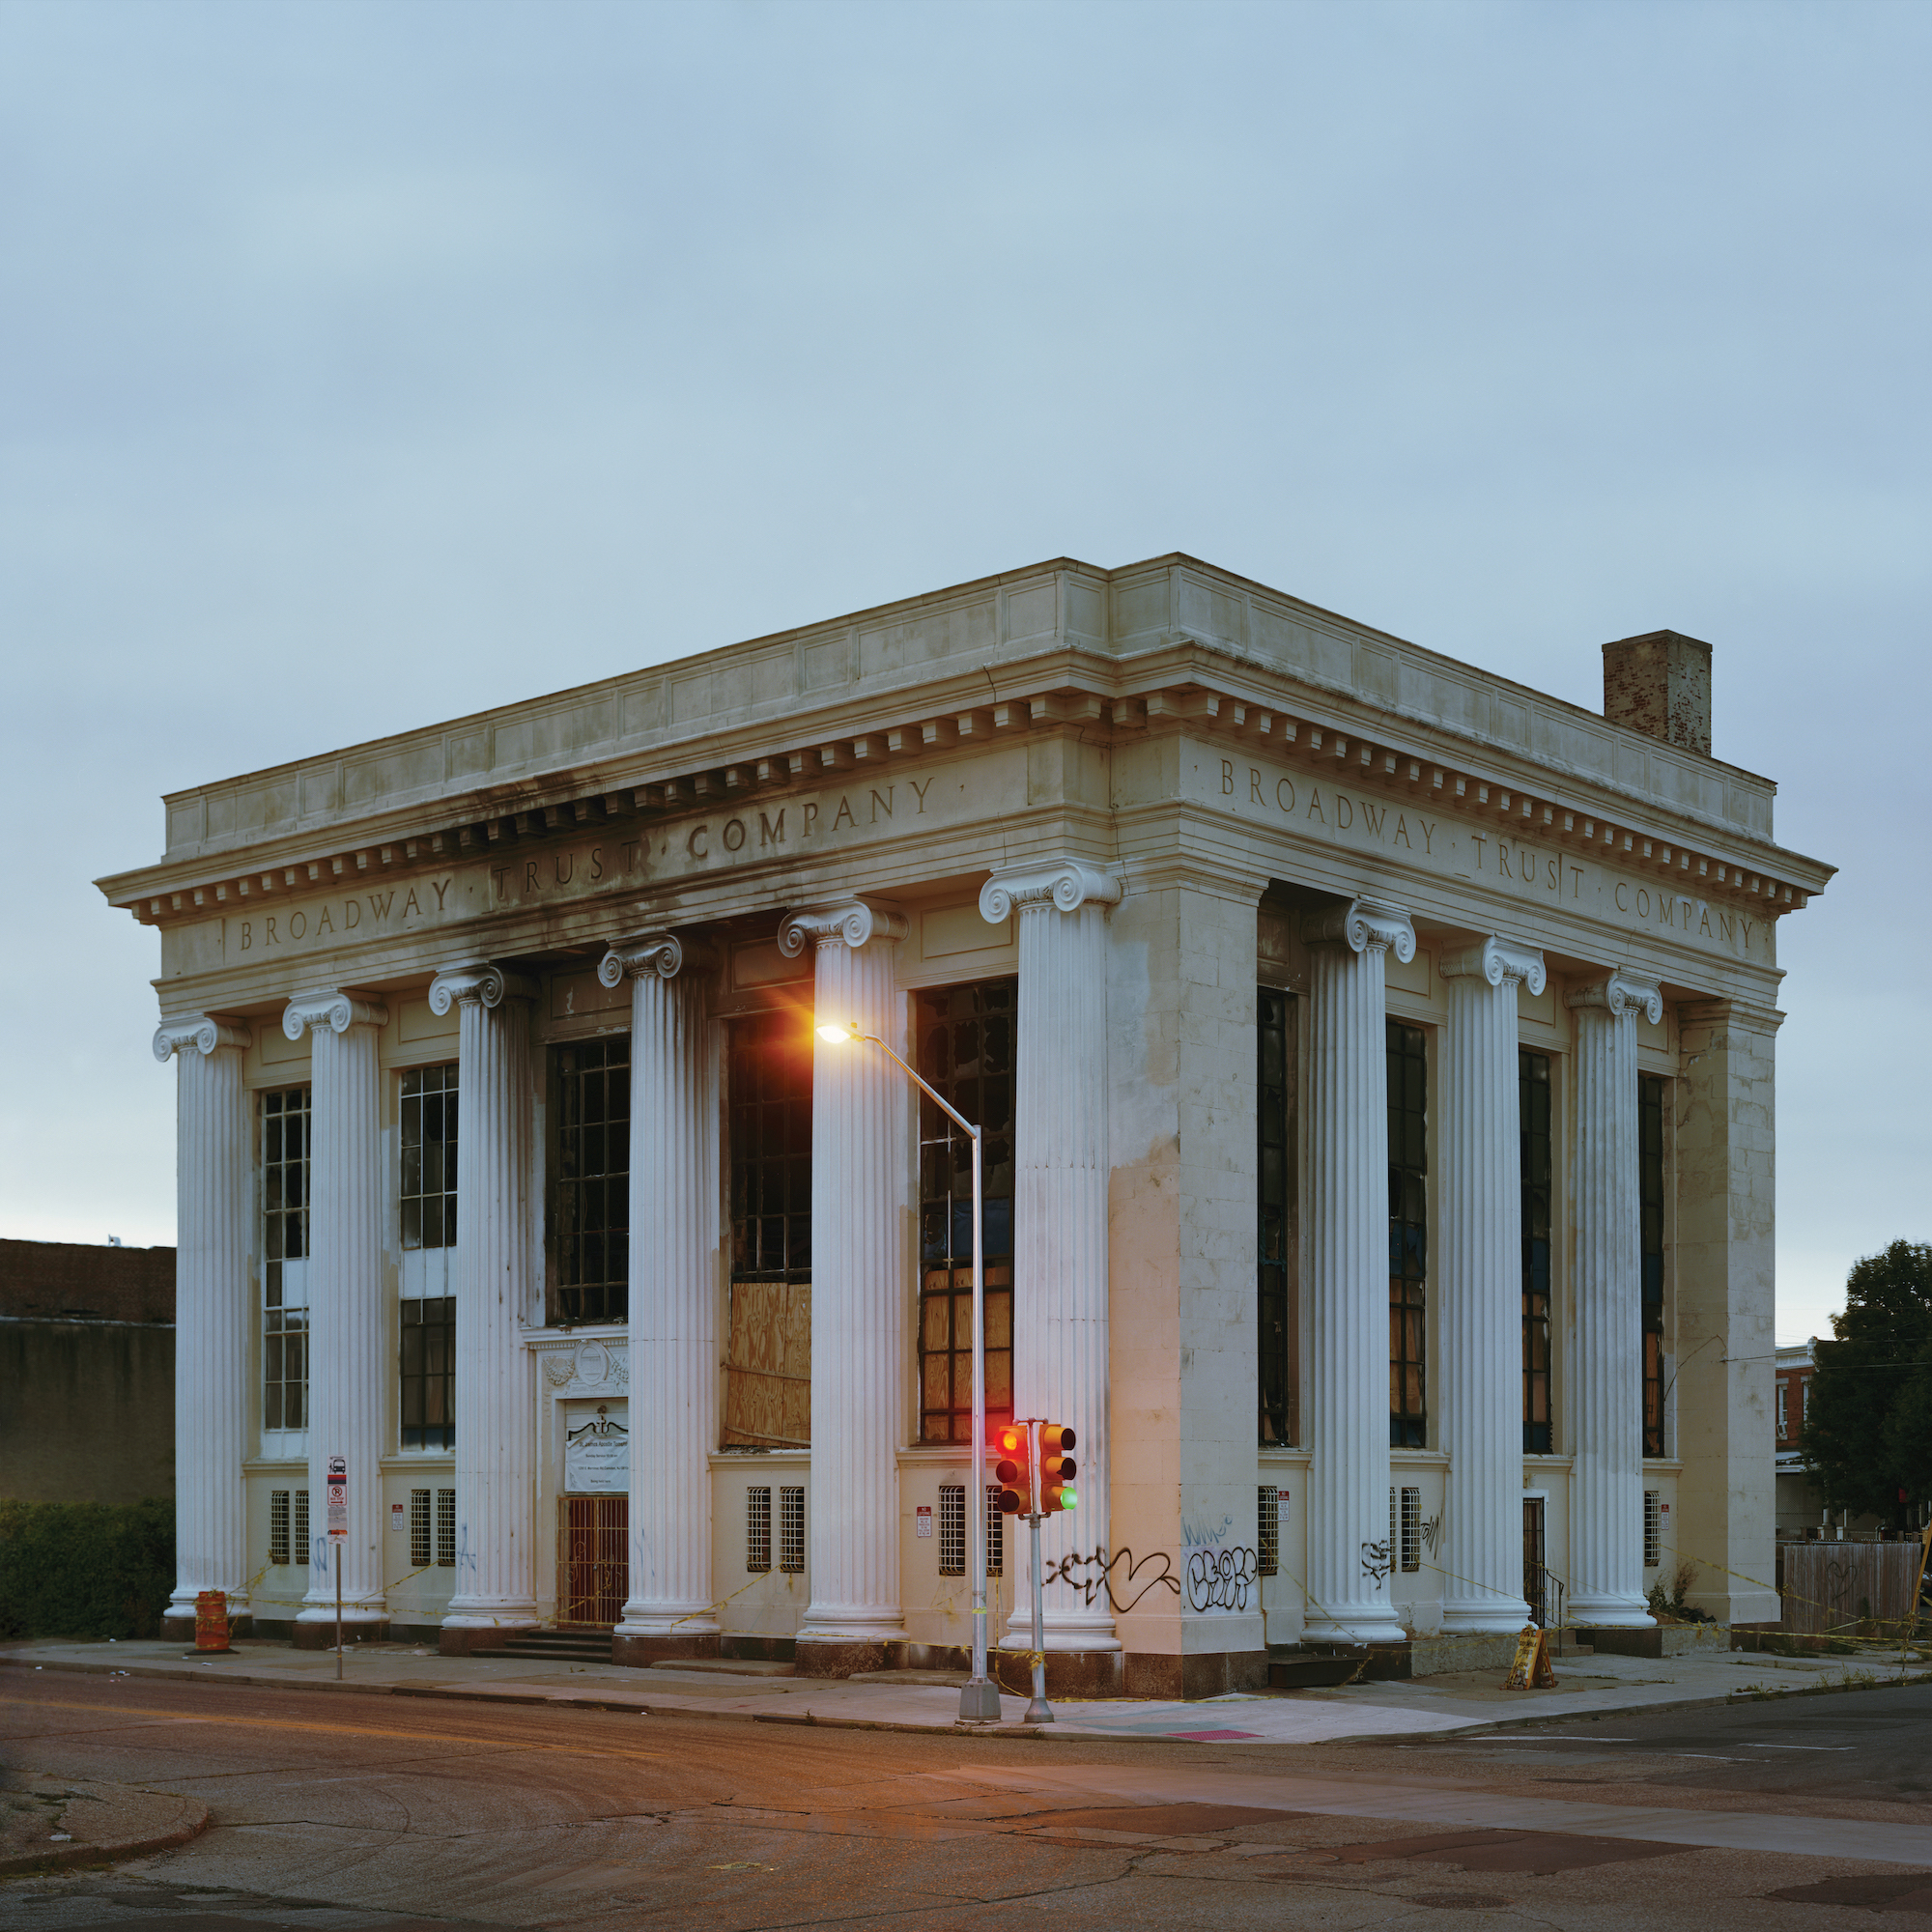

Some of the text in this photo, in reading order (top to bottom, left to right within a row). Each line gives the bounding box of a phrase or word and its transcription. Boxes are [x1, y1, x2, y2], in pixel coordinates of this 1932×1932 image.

[241, 777, 935, 951] BROADWAY TRUST COMPANY
[1218, 758, 1752, 949] BROADWAY TRUST COMPANY
